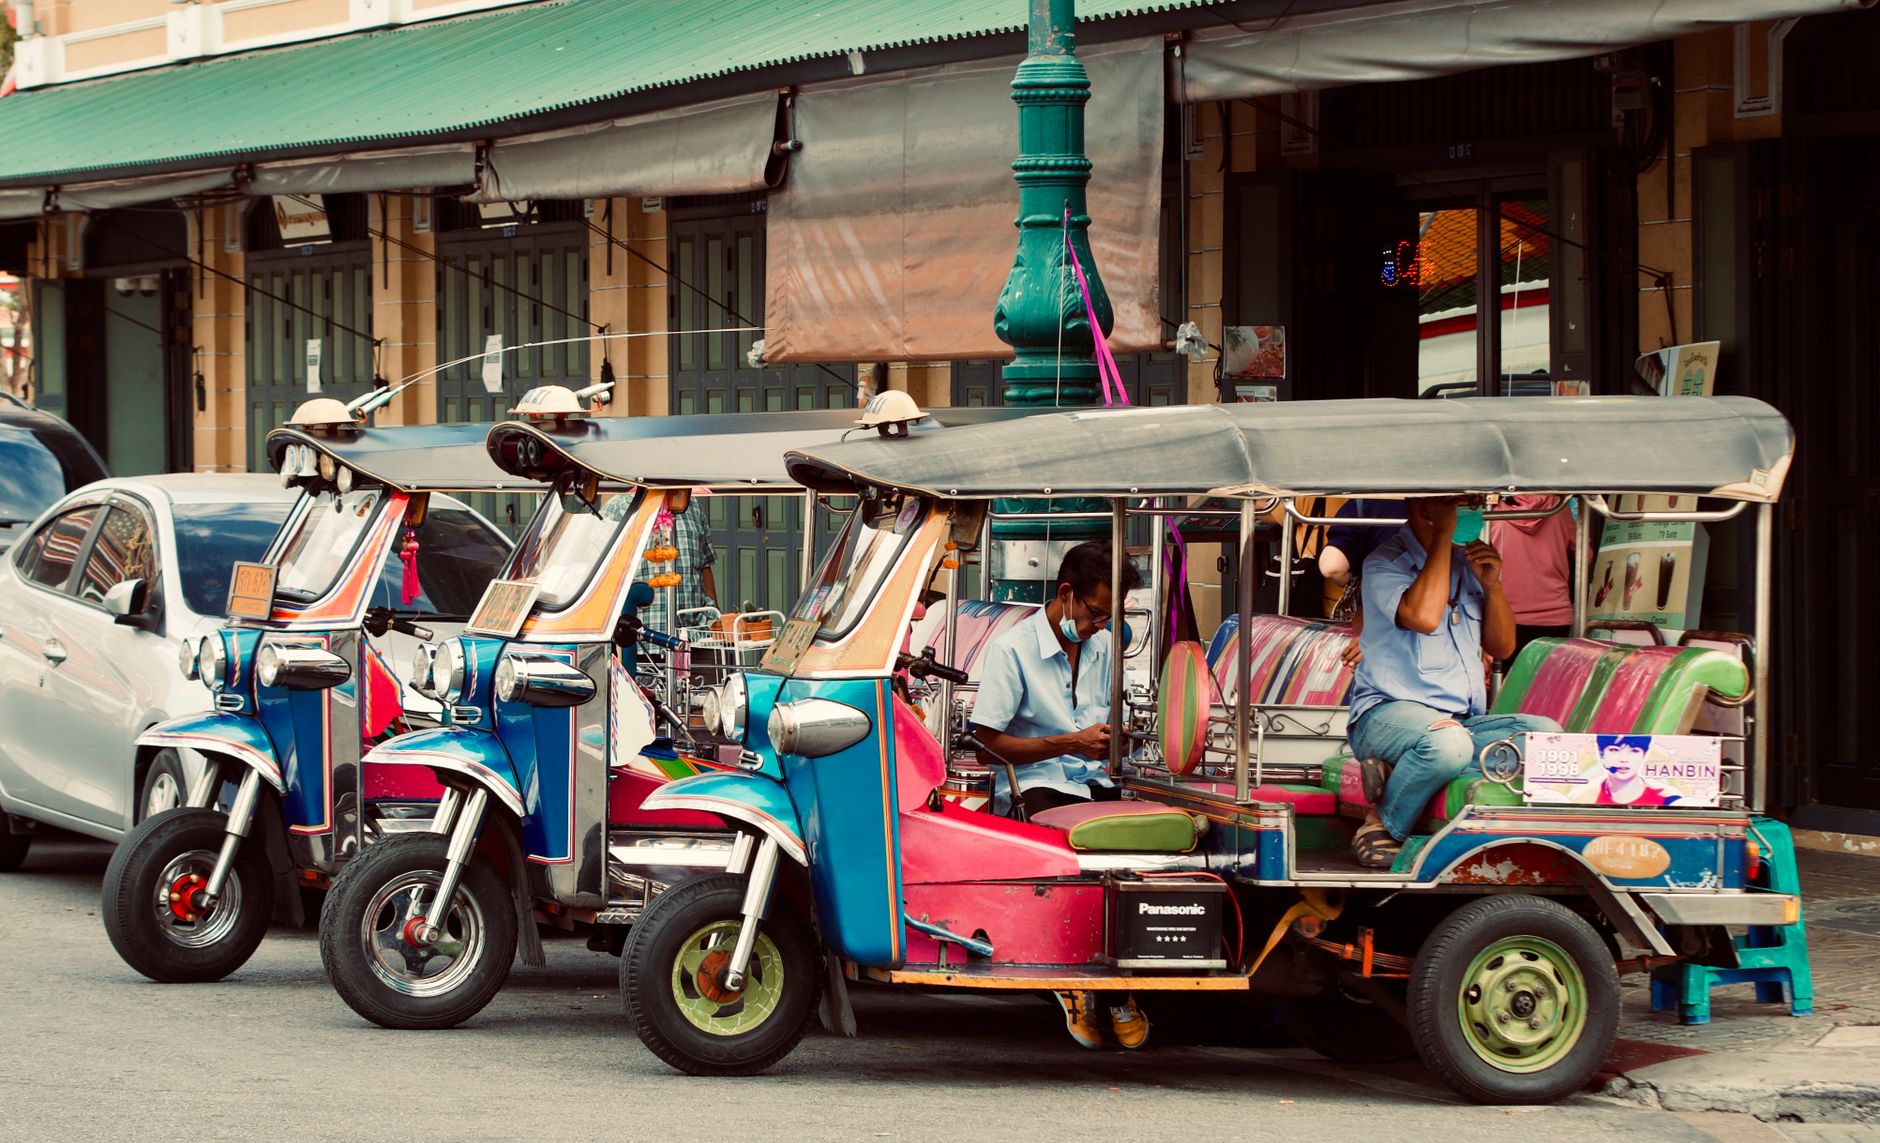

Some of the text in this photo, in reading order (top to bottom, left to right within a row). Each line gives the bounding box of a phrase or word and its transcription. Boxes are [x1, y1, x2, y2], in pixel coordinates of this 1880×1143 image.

[1539, 750, 1578, 763] 1901
[1539, 763, 1580, 776] 1998
[1645, 764, 1716, 777] HANBIN
[1139, 902, 1206, 916] Panasonic
